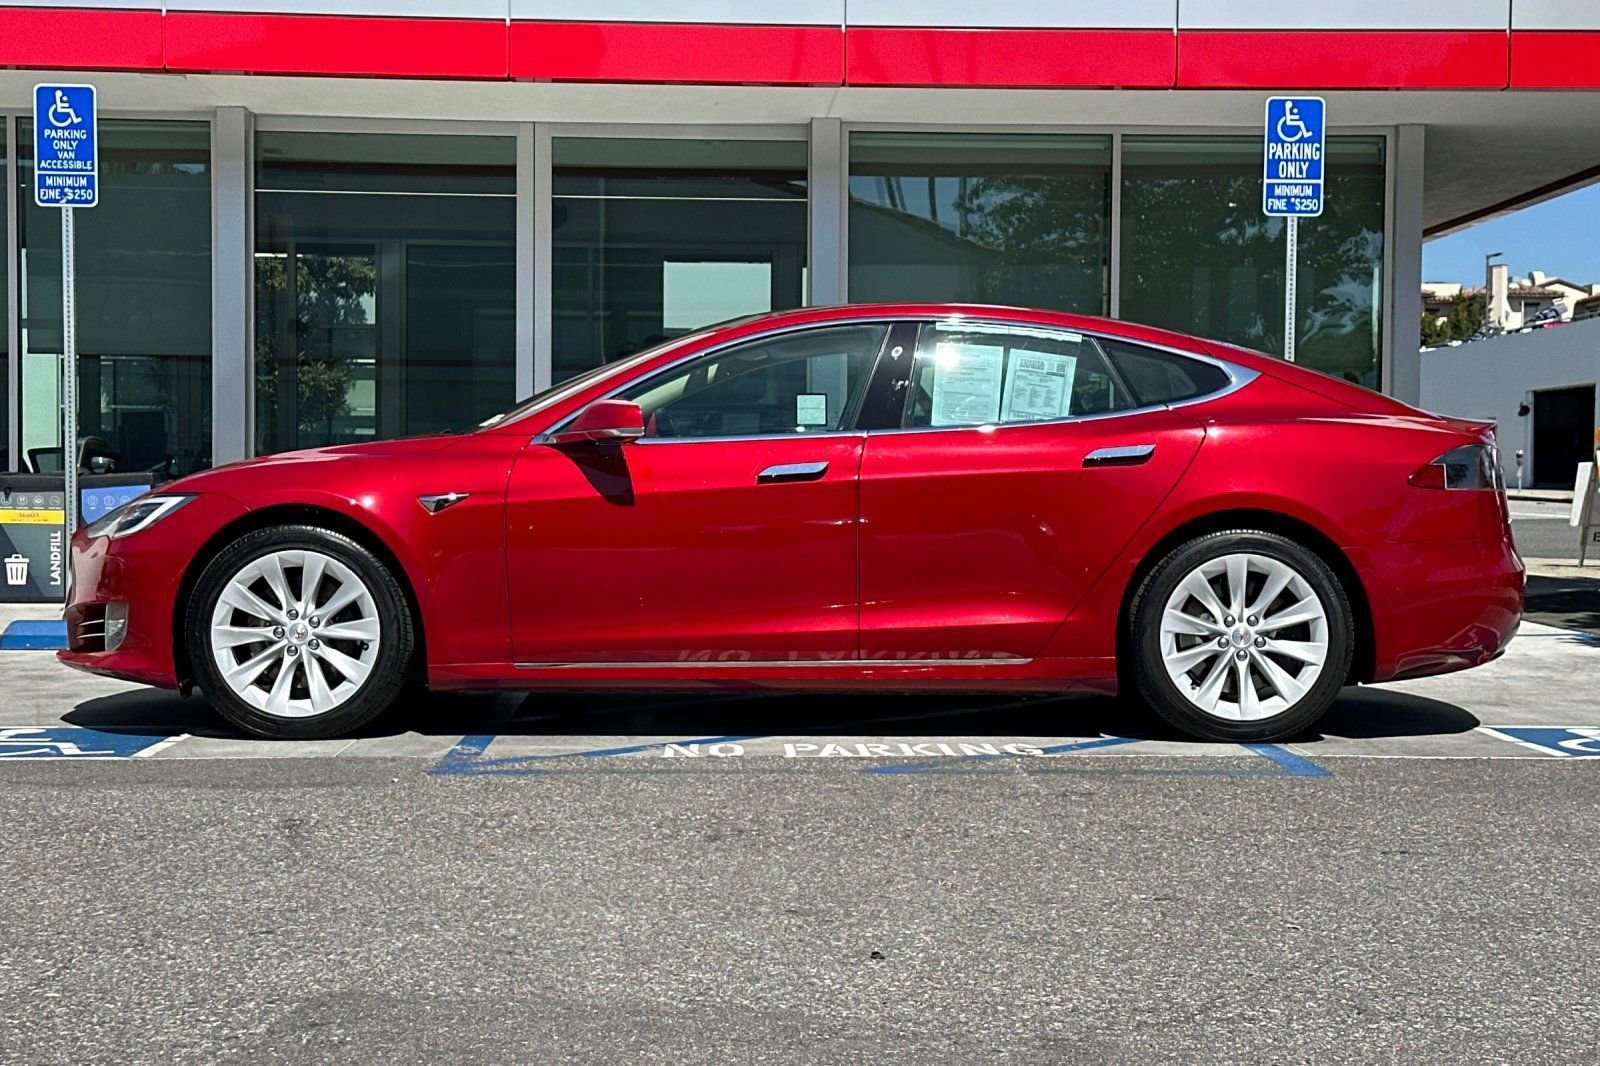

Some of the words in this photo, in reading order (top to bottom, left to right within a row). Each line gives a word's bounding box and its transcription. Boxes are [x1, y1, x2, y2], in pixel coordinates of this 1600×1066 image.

[44, 129, 87, 139] PARKING
[53, 140, 78, 150] ONLY
[57, 151, 75, 159] VAN
[1268, 142, 1320, 160] PARKING
[40, 160, 92, 170] ACCESSIBLE
[1278, 161, 1309, 178] ONLY
[45, 176, 87, 187] MINIMUM
[40, 189, 60, 200] FINE
[1274, 185, 1312, 197] MINIMUM
[1267, 198, 1287, 210] FINE
[1294, 198, 1318, 211] $250
[50, 530, 61, 585] LANDFILL
[660, 743, 745, 758] NO
[782, 743, 1044, 758] PARKING
